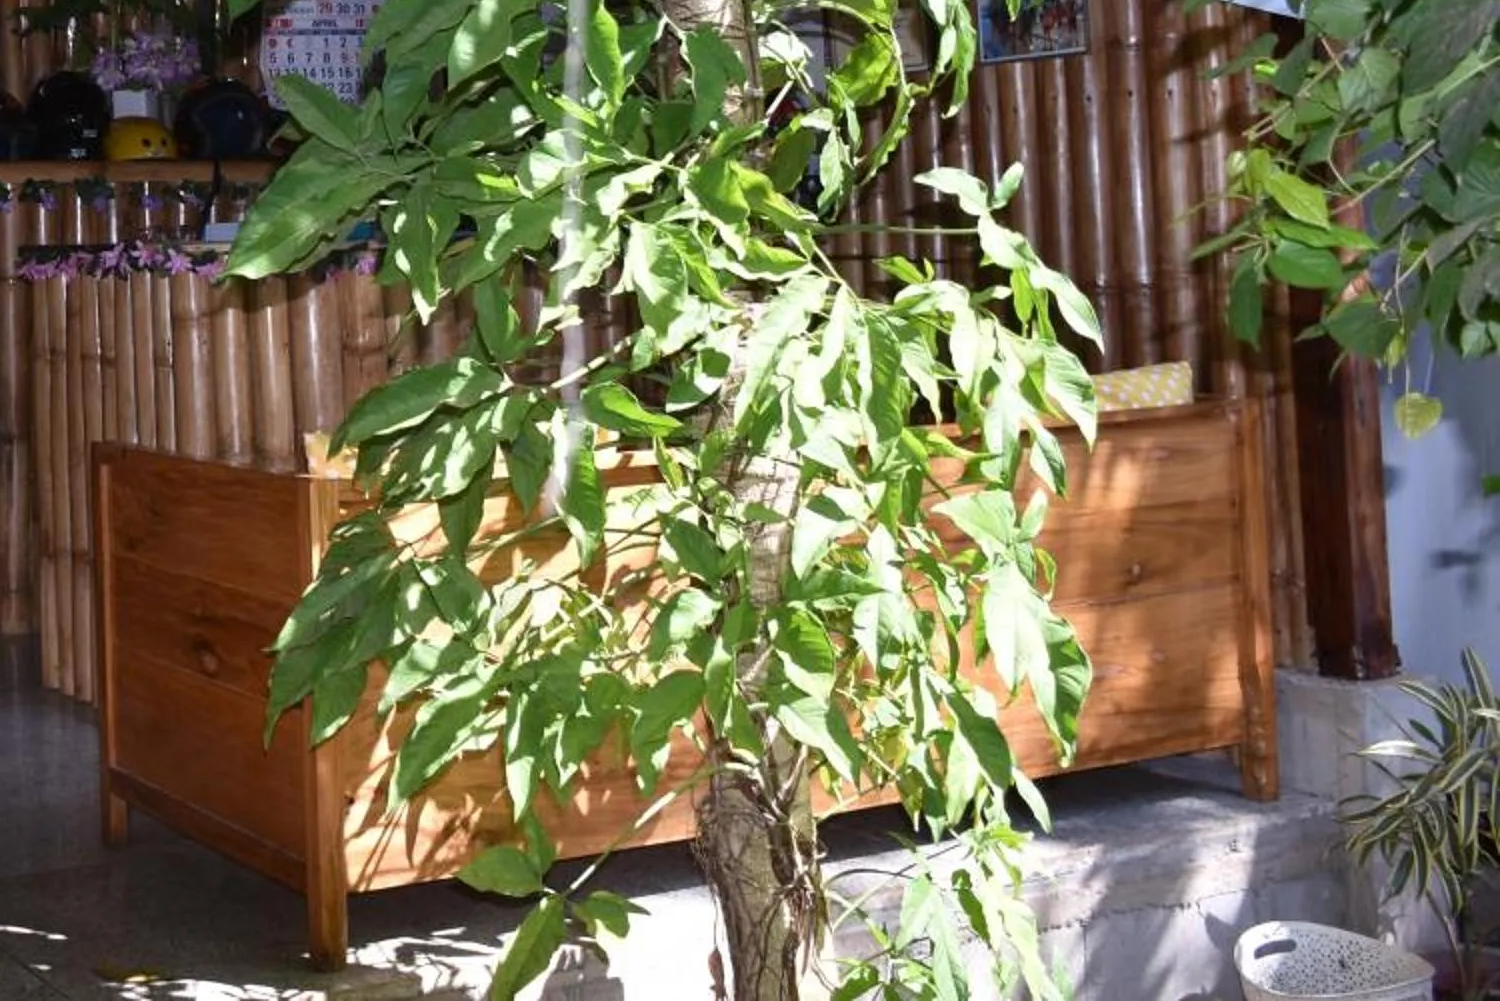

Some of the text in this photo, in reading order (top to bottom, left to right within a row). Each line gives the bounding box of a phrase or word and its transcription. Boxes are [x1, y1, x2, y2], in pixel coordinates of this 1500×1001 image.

[319, 2, 332, 15] 29
[336, 3, 349, 15] 30
[352, 3, 365, 15] 31
[323, 37, 347, 48] 1 2
[269, 52, 277, 64] 5
[305, 52, 313, 63] 7
[320, 67, 335, 79] 15
[339, 67, 353, 78] 16
[339, 82, 353, 94] 23
